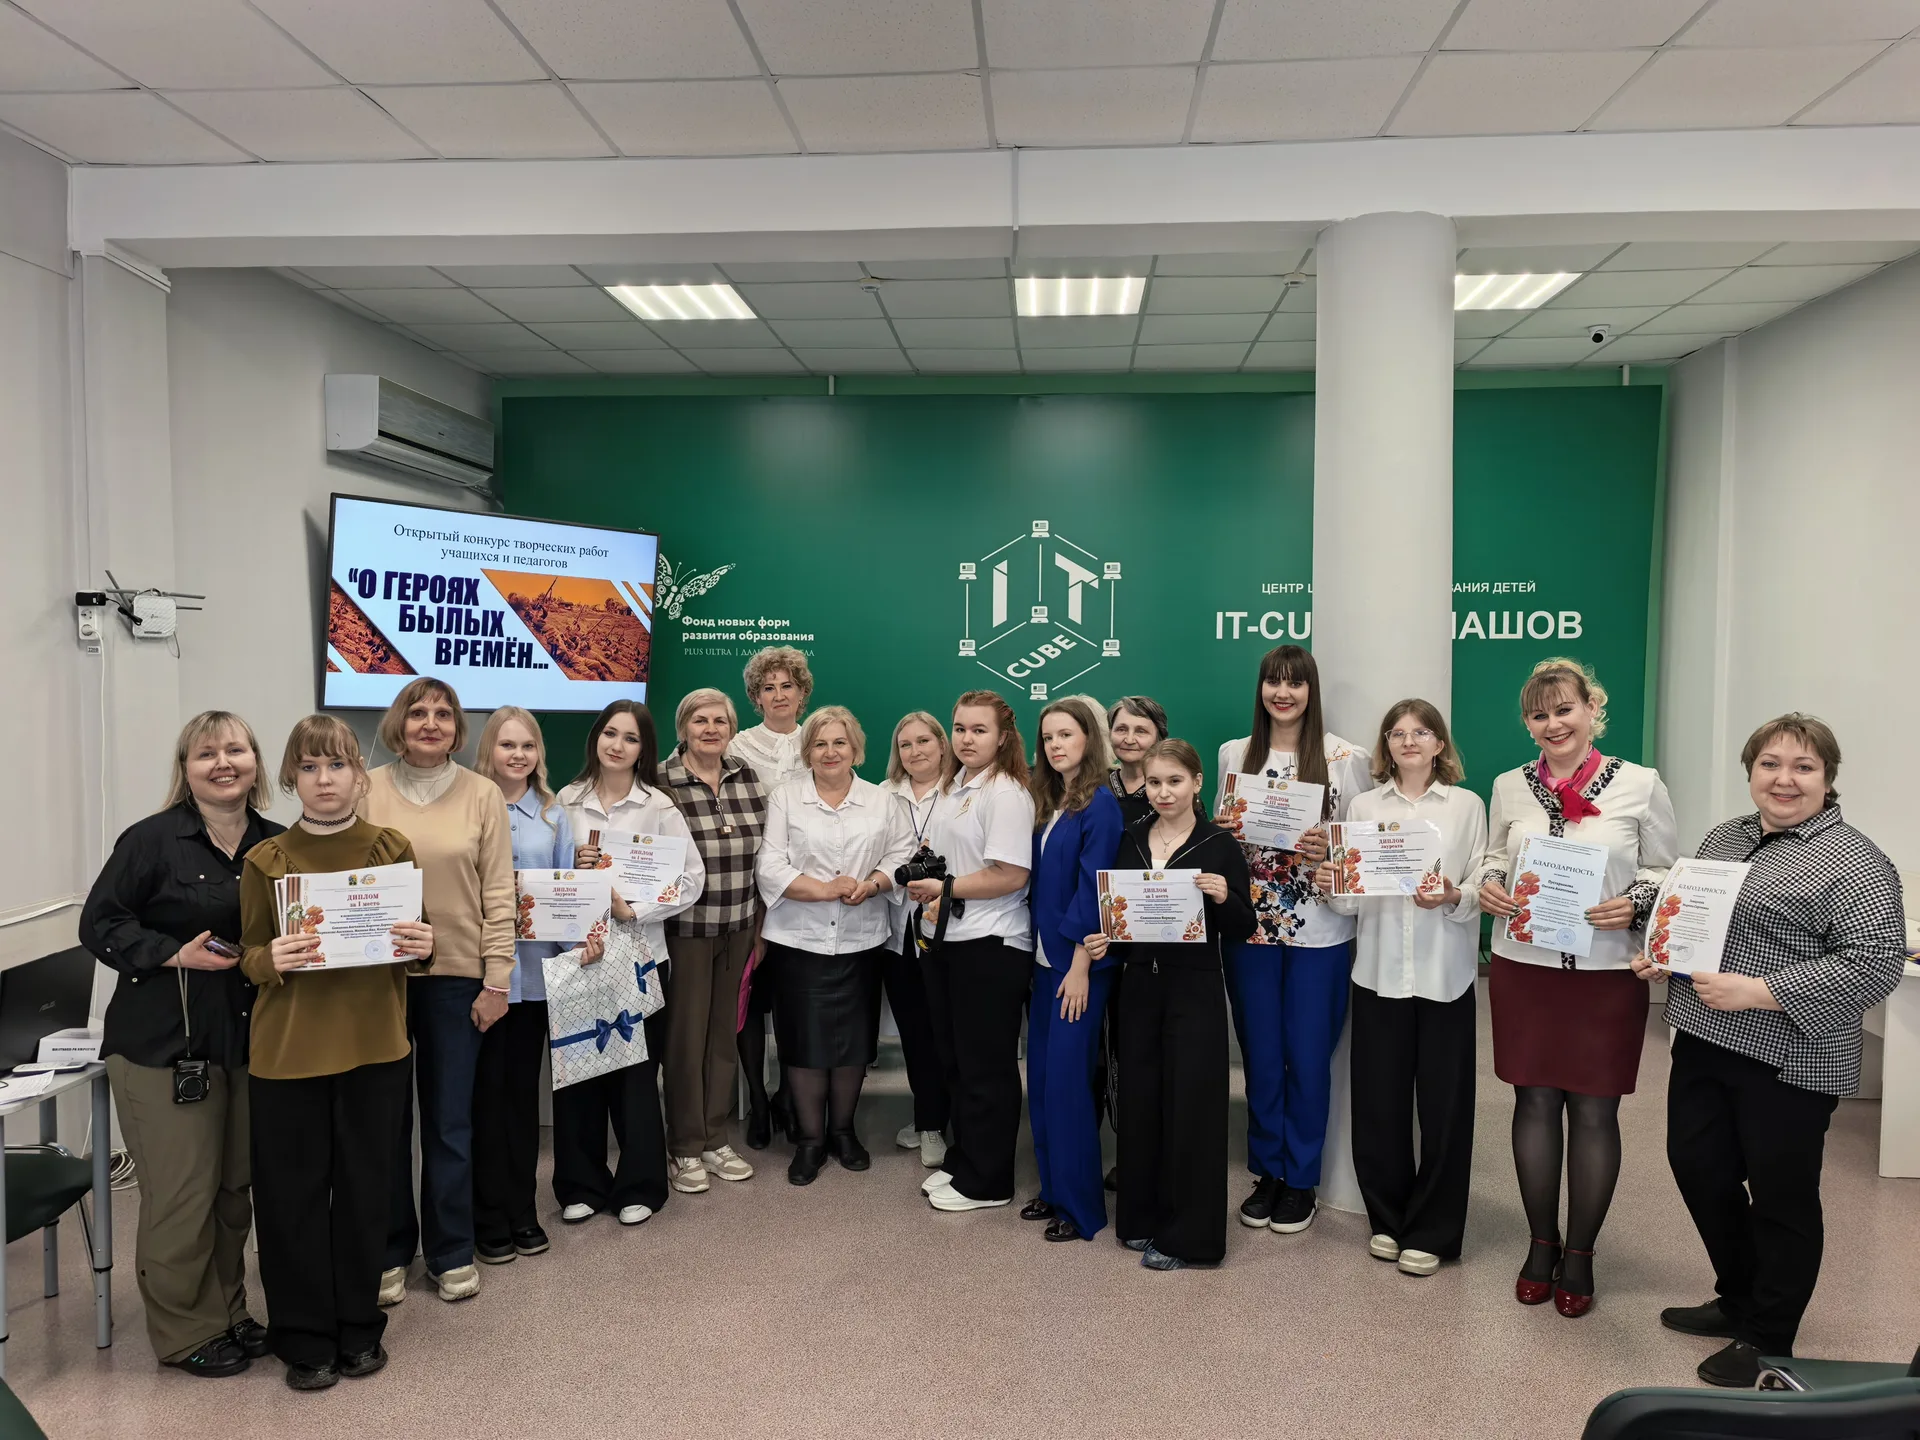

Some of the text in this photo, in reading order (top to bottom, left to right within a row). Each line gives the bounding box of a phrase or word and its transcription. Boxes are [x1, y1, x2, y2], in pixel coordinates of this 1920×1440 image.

[394, 523, 609, 558] Открытый конкурс творческих работ
[441, 548, 568, 569] учащихся и педагогов
[383, 571, 480, 606] ГЕРОЯХ
[1262, 583, 1304, 595] ЦЕНТР
[1492, 580, 1536, 594] ДЕТЕЙ
[399, 604, 505, 637] БЫЛЫХ
[681, 616, 790, 629] Фонд новых форм
[1216, 611, 1312, 640] IT-CU
[682, 630, 815, 643] развития образования
[434, 637, 549, 670] ВРЕМЁН...
[705, 648, 732, 656] ULTRA
[1006, 634, 1078, 678] CUBE
[1533, 859, 1595, 876] БЛАГОДАРНОСТЬ
[347, 893, 379, 901] ДИПЛОМ
[1678, 884, 1727, 895] БЛАГОДАРНОСТЬ
